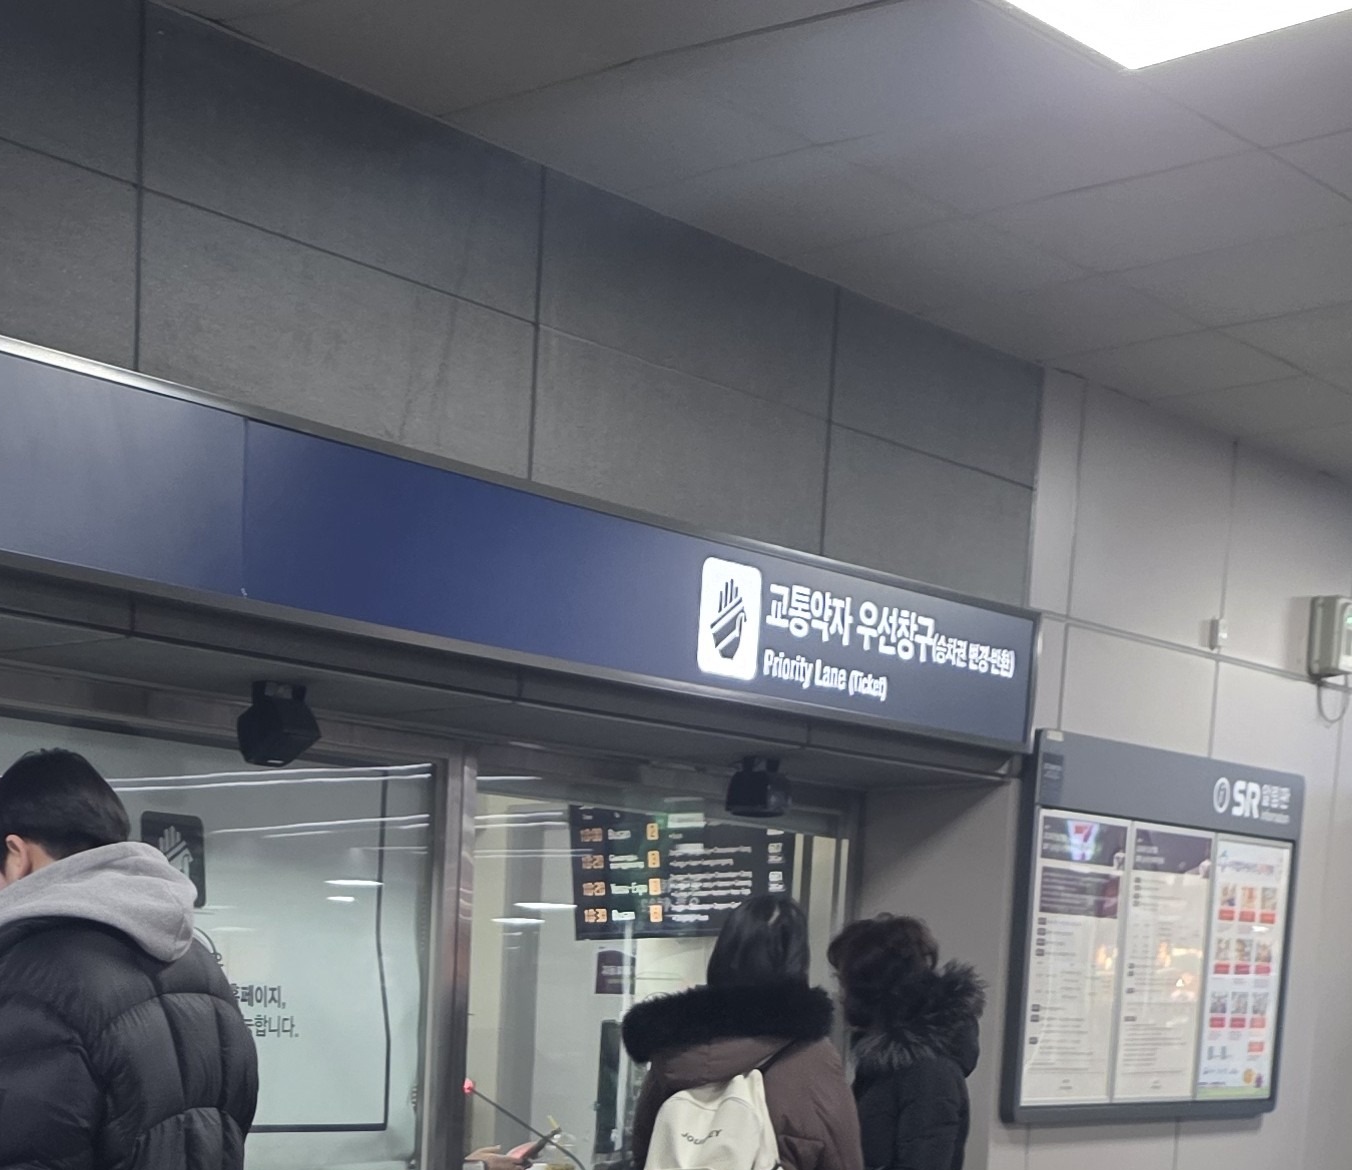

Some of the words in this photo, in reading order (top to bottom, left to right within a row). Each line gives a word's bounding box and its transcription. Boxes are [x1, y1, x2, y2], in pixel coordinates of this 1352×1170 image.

[765, 583, 854, 646] 교통약자
[763, 649, 814, 690] Priority
[814, 658, 846, 687] Lane
[848, 669, 888, 702] (Ticket)
[1231, 780, 1261, 818] SR
